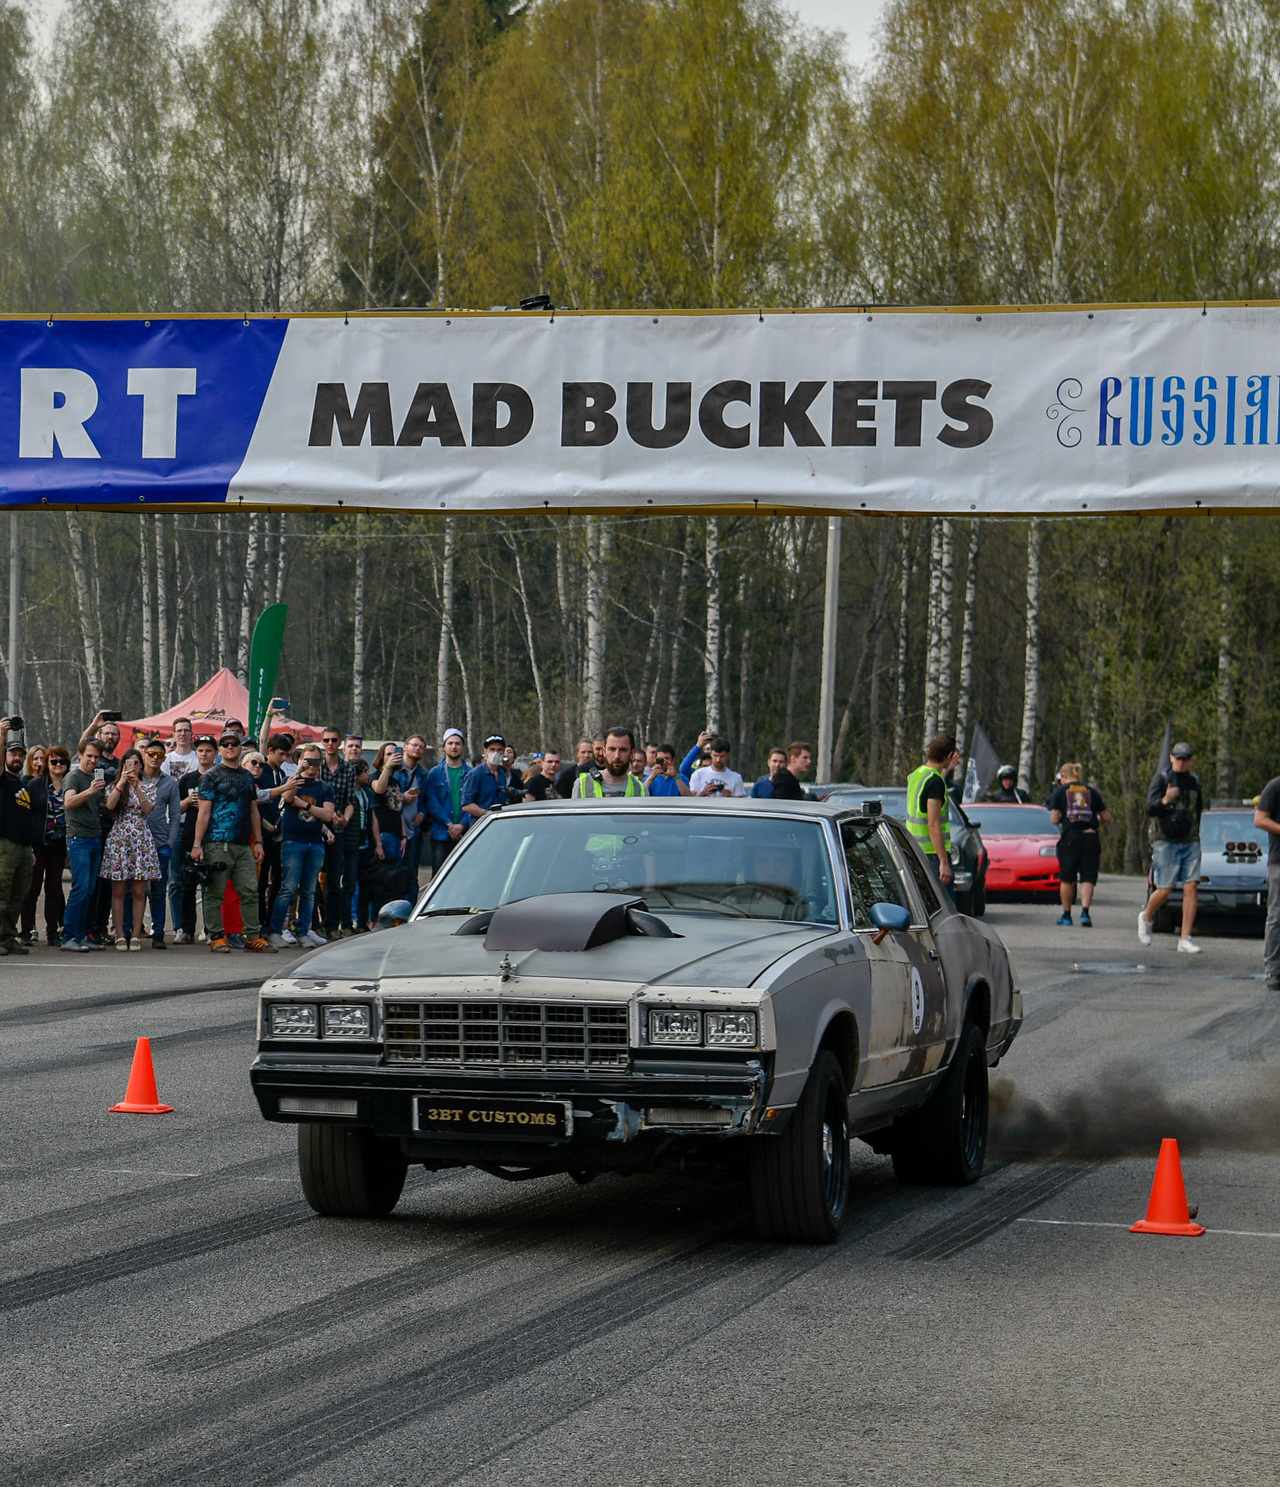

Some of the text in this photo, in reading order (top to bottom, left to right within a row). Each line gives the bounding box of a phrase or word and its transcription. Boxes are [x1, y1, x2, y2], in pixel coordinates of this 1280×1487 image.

[307, 378, 994, 450] MAD BUCKETS
[1097, 374, 1280, 447] RUSSIA
[427, 1108, 557, 1126] 3BT CUSTOMS
